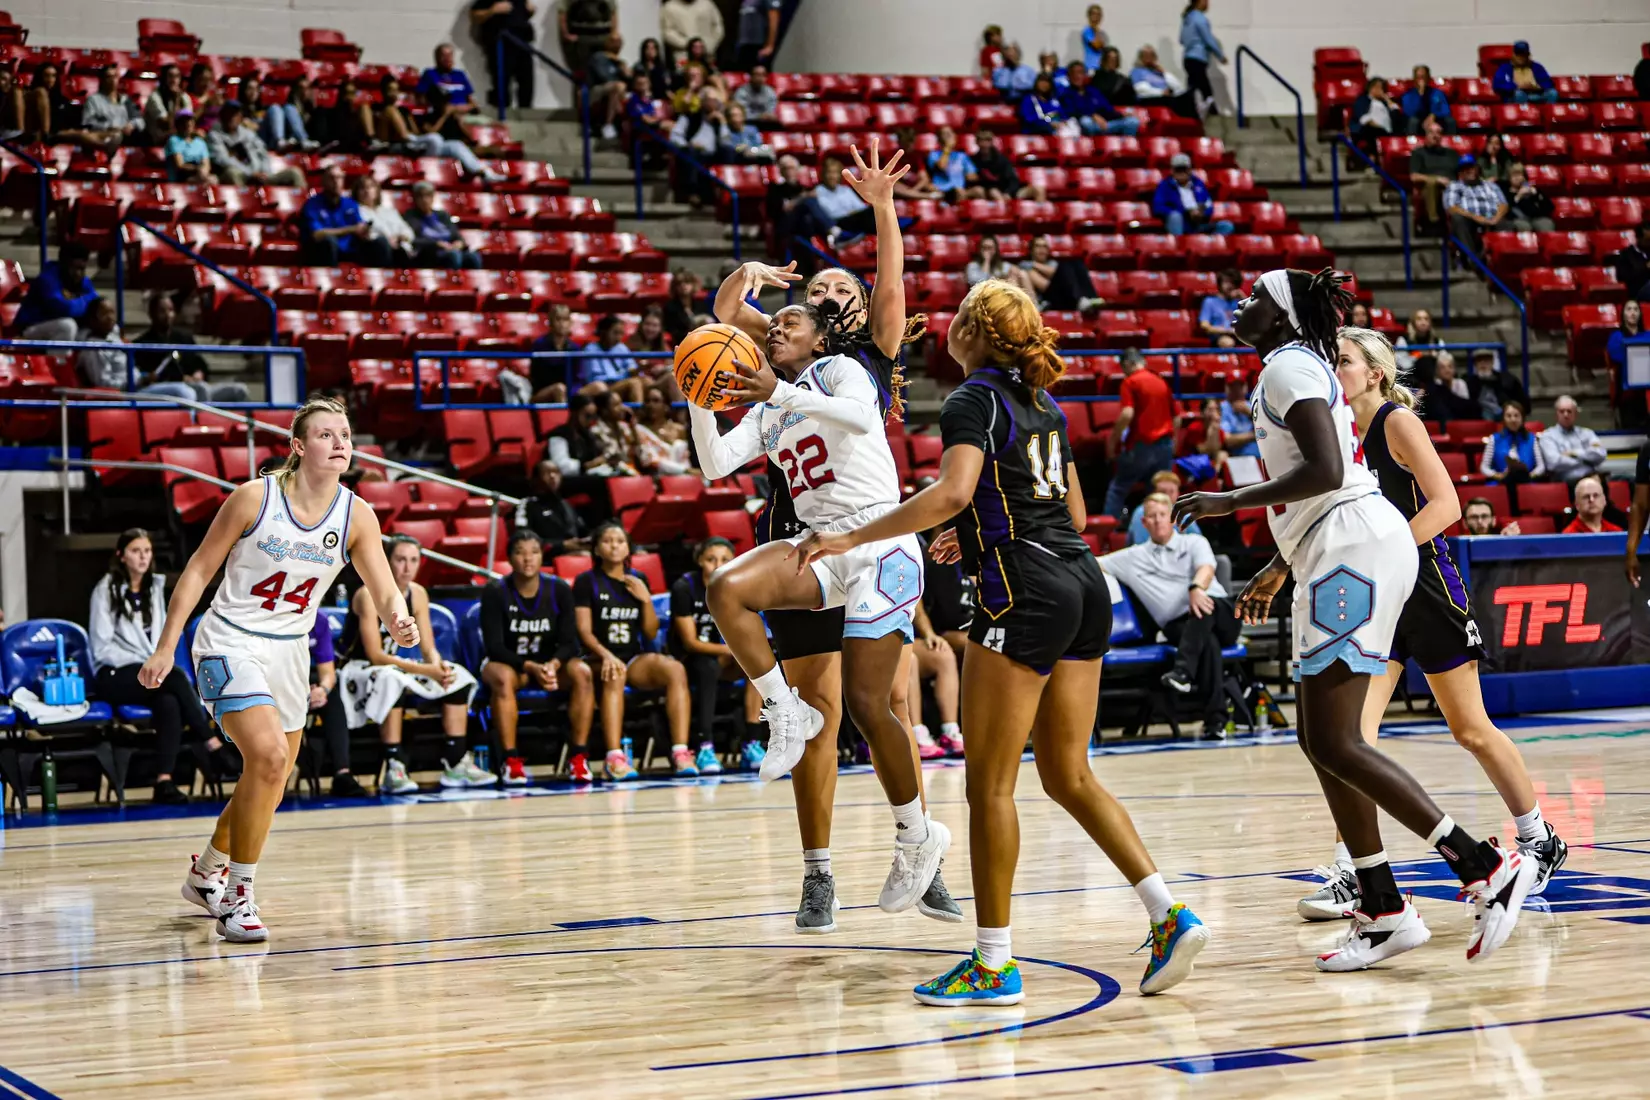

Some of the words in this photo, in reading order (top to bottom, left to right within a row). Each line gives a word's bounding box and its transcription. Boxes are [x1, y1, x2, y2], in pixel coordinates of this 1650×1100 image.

[778, 433, 837, 499] 22
[1027, 430, 1068, 499] 14
[257, 534, 291, 562] Lady
[250, 570, 319, 614] 44
[510, 618, 551, 632] LSUA
[601, 607, 639, 620] LSUA
[517, 635, 541, 655] 24
[608, 623, 630, 643] 25
